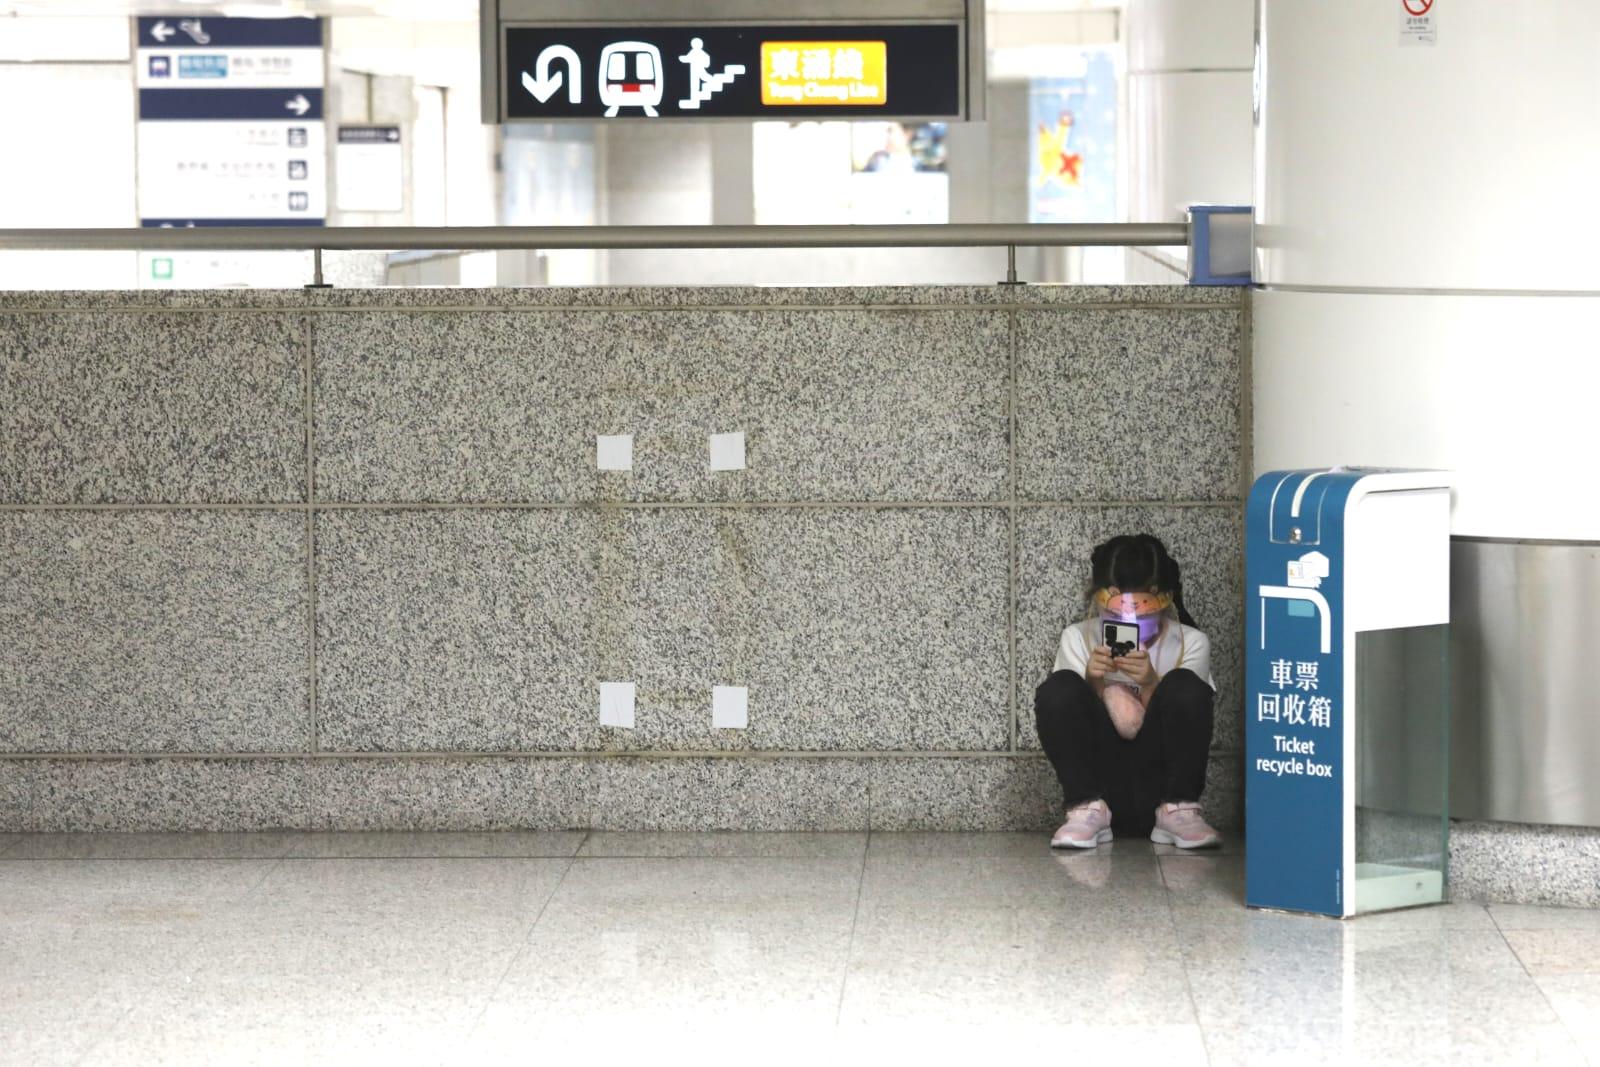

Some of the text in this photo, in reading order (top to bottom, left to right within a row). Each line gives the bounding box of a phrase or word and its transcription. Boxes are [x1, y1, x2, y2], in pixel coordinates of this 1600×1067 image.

[1269, 658, 1320, 691] 車票
[1257, 692, 1332, 728] 回收箱
[1273, 735, 1315, 755] Ticket
[1256, 757, 1333, 778] recycle box
